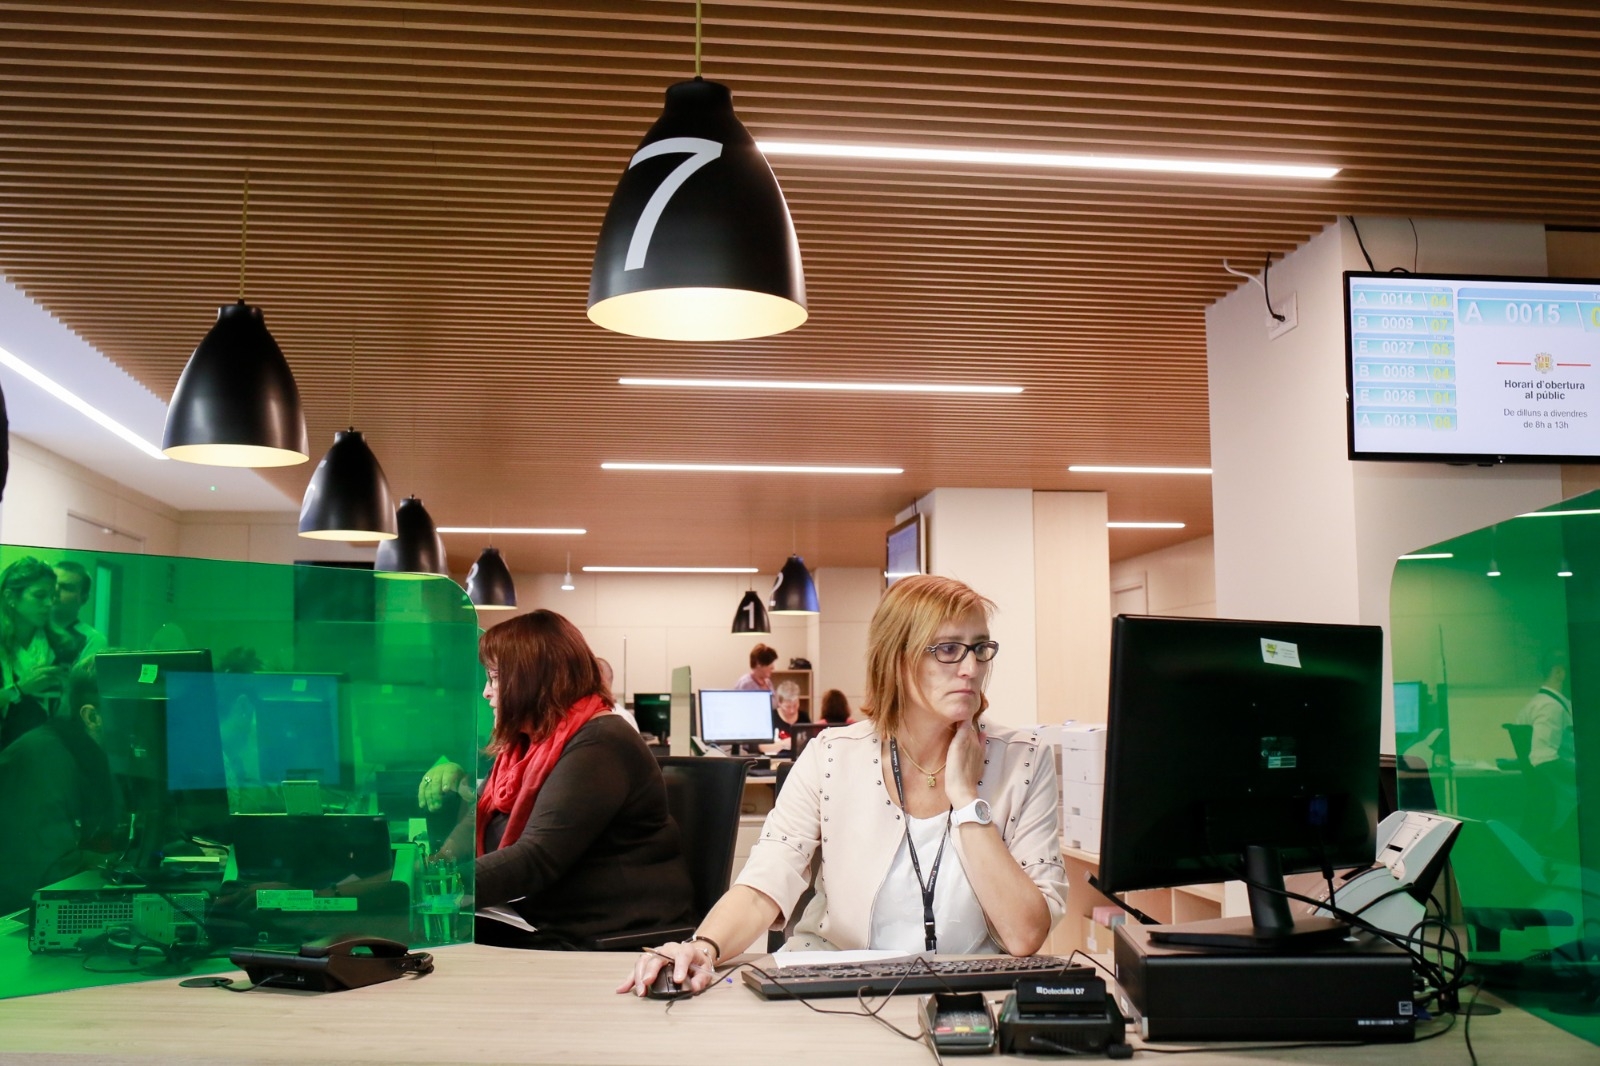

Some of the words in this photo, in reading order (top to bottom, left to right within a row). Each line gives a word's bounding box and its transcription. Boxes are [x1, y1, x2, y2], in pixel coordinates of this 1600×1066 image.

[624, 136, 724, 272] 7
[1357, 292, 1368, 304] A
[1381, 292, 1413, 305] 0014
[1465, 301, 1483, 322] A
[1505, 302, 1560, 323] 0015
[1358, 316, 1368, 328] B
[1382, 317, 1414, 329] 0009
[1431, 319, 1448, 332] 07
[1359, 340, 1368, 353] E
[1382, 341, 1415, 354] 0027
[1359, 365, 1369, 377] B
[1383, 365, 1415, 378] 0008
[1504, 380, 1533, 389] Horari
[1536, 380, 1585, 390] d'obertura
[1360, 389, 1370, 402] E
[1384, 390, 1416, 403] 0026
[1525, 390, 1533, 399] al
[1536, 390, 1566, 401] públic
[1503, 408, 1515, 416] De
[1516, 408, 1541, 417] dilluns
[1550, 409, 1588, 418] divendres
[1360, 414, 1371, 426] A
[1385, 414, 1417, 427] 0013
[1523, 420, 1533, 428] de
[1535, 421, 1545, 429] 8h
[1555, 421, 1569, 429] 13h
[743, 601, 755, 629] 1
[1075, 987, 1085, 996] D7
